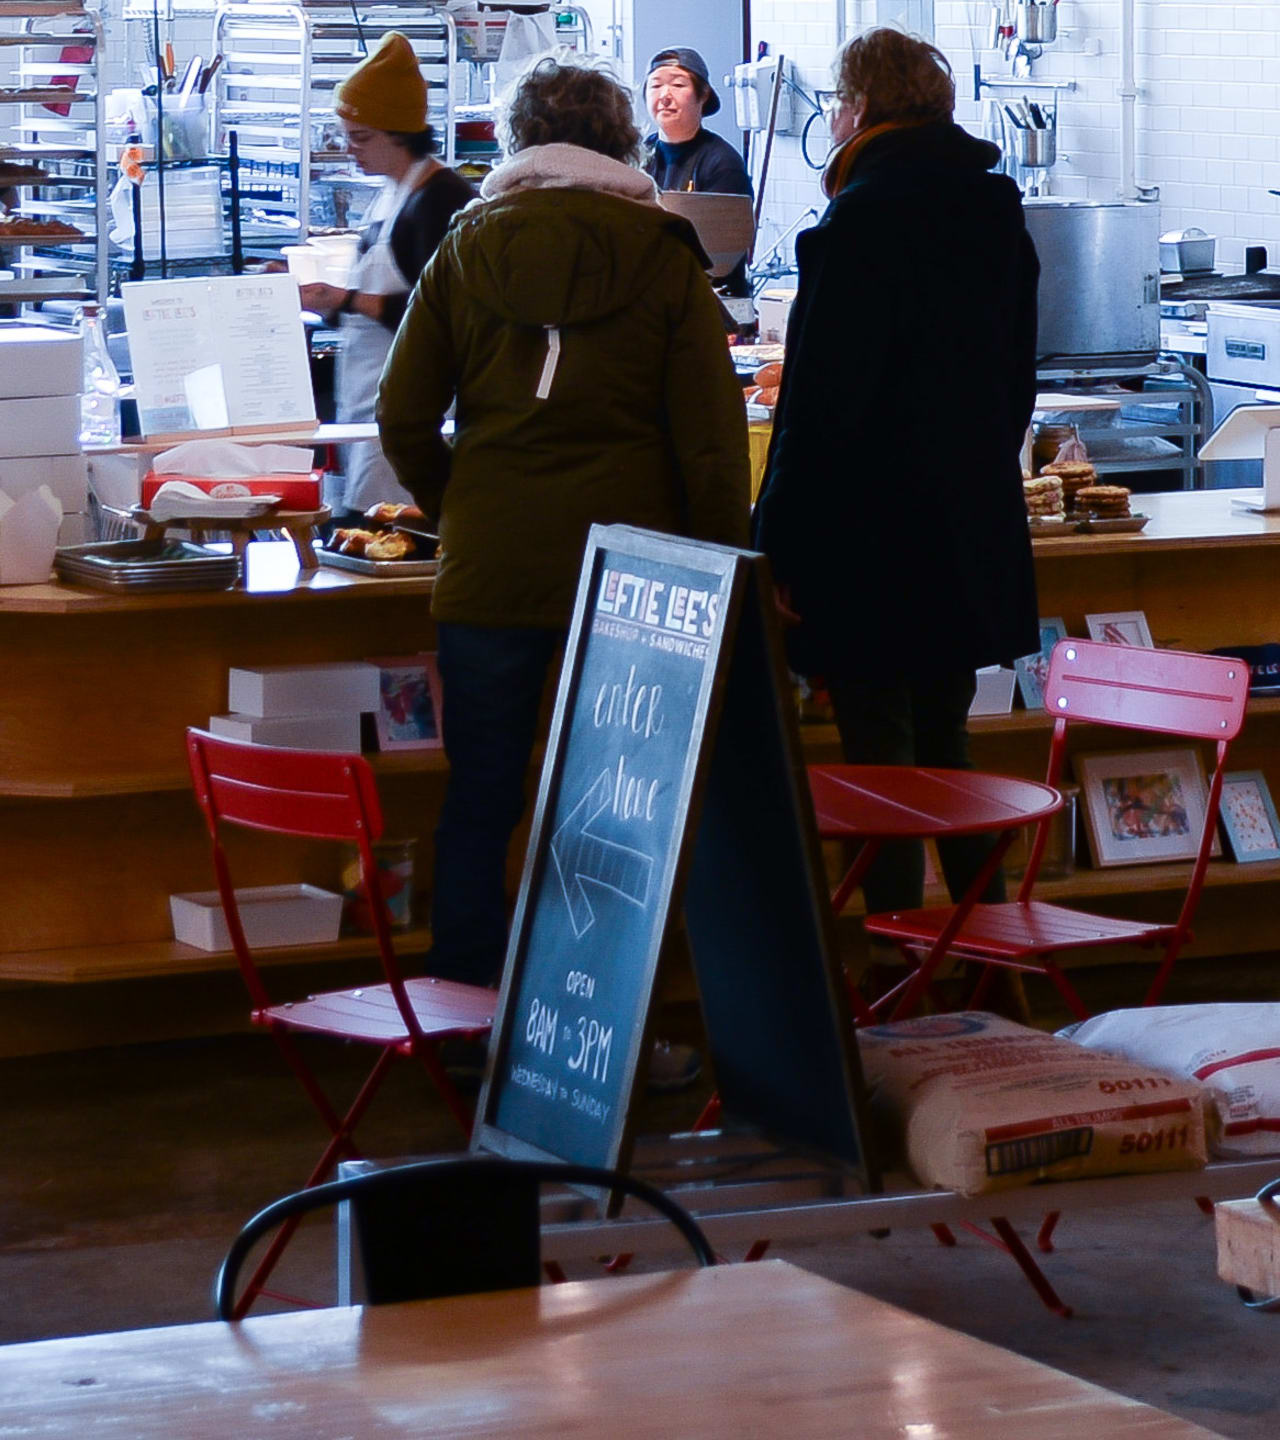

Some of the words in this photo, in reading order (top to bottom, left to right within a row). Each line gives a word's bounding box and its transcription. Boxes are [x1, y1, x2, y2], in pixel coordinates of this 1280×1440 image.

[597, 568, 665, 626] LEFTIE
[665, 584, 719, 638] LEE'S
[591, 618, 639, 642] BAKESHOP
[566, 970, 596, 1000] OPEN
[526, 998, 559, 1055] 8AM
[568, 1015, 613, 1084] 3PM
[511, 1063, 560, 1101] WEDNESDAY
[571, 1088, 611, 1125] SUNDAY
[1051, 1116, 1069, 1128] ALL
[1120, 1125, 1190, 1156] 50111
